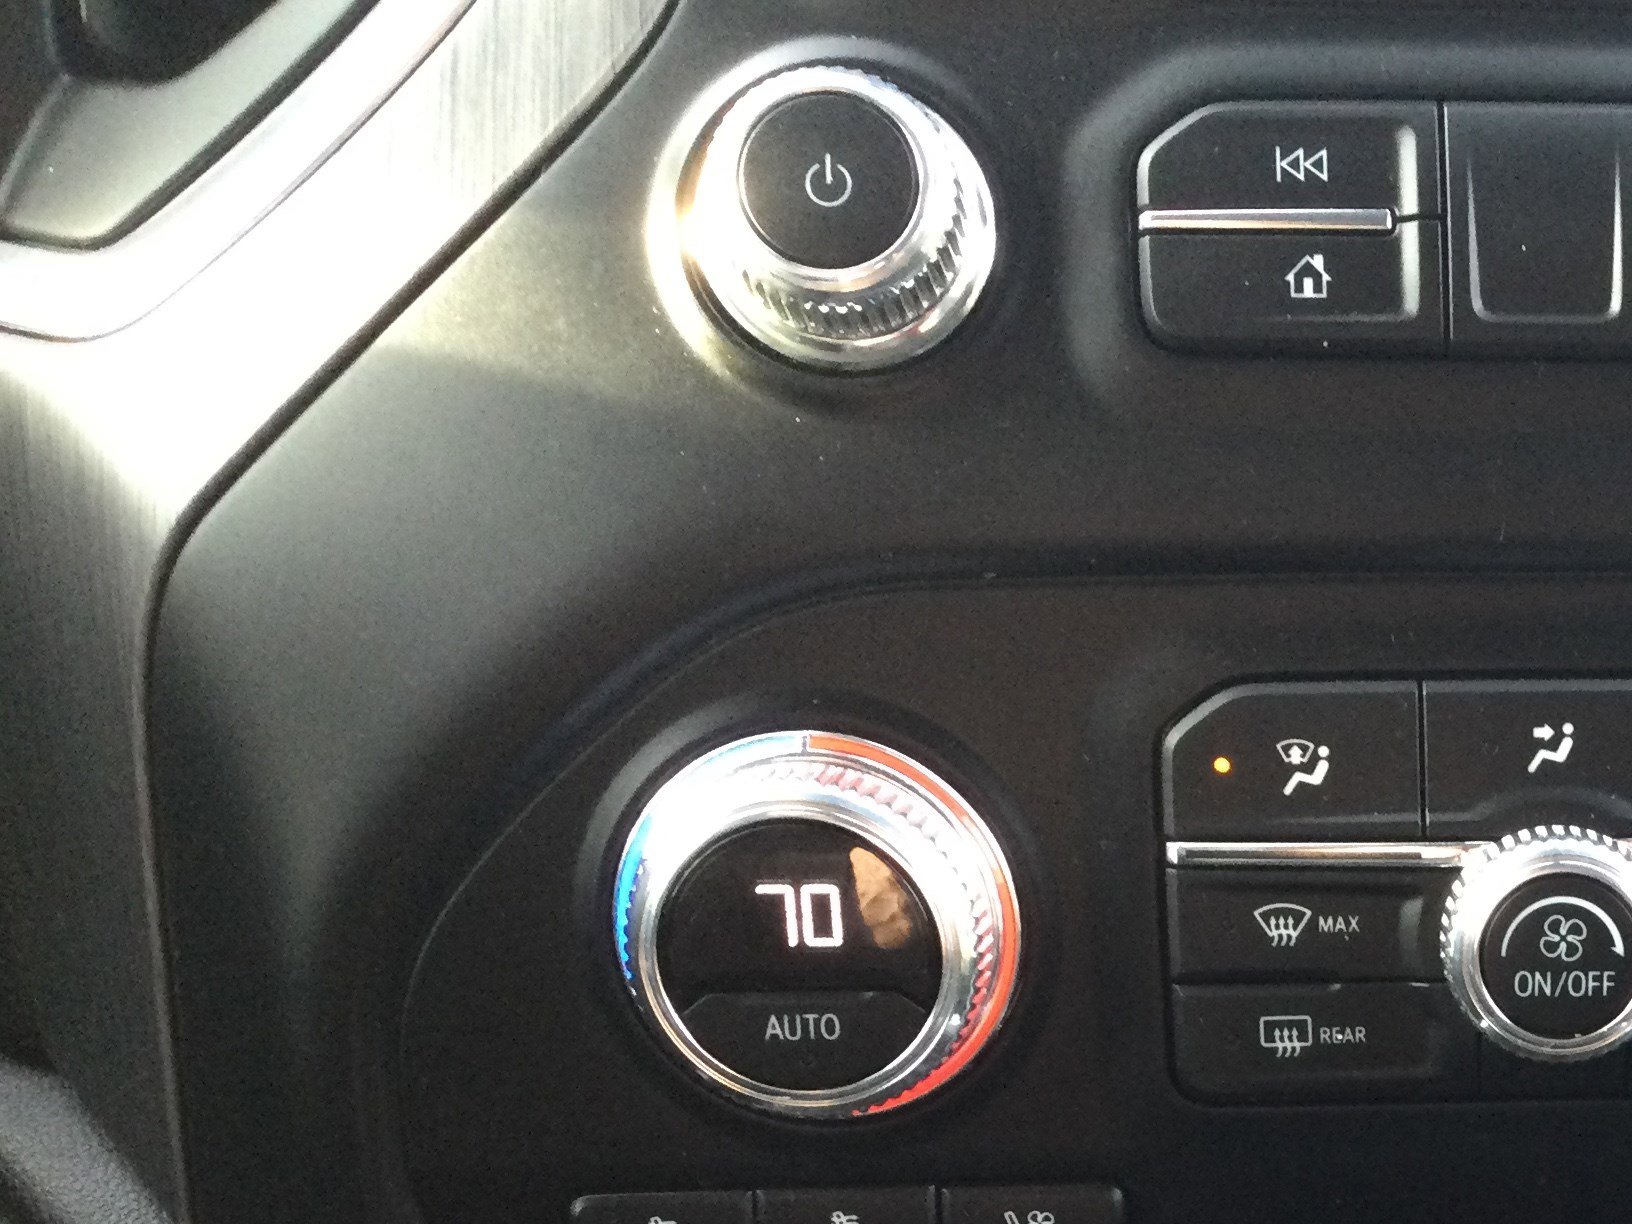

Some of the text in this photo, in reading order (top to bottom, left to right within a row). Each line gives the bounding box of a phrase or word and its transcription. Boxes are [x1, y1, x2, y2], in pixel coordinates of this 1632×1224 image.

[754, 883, 844, 948] 70
[1318, 914, 1360, 933] MAX
[1514, 970, 1616, 998] ON/OFF
[764, 1012, 841, 1042] AUTO
[1319, 1026, 1366, 1044] REAR
